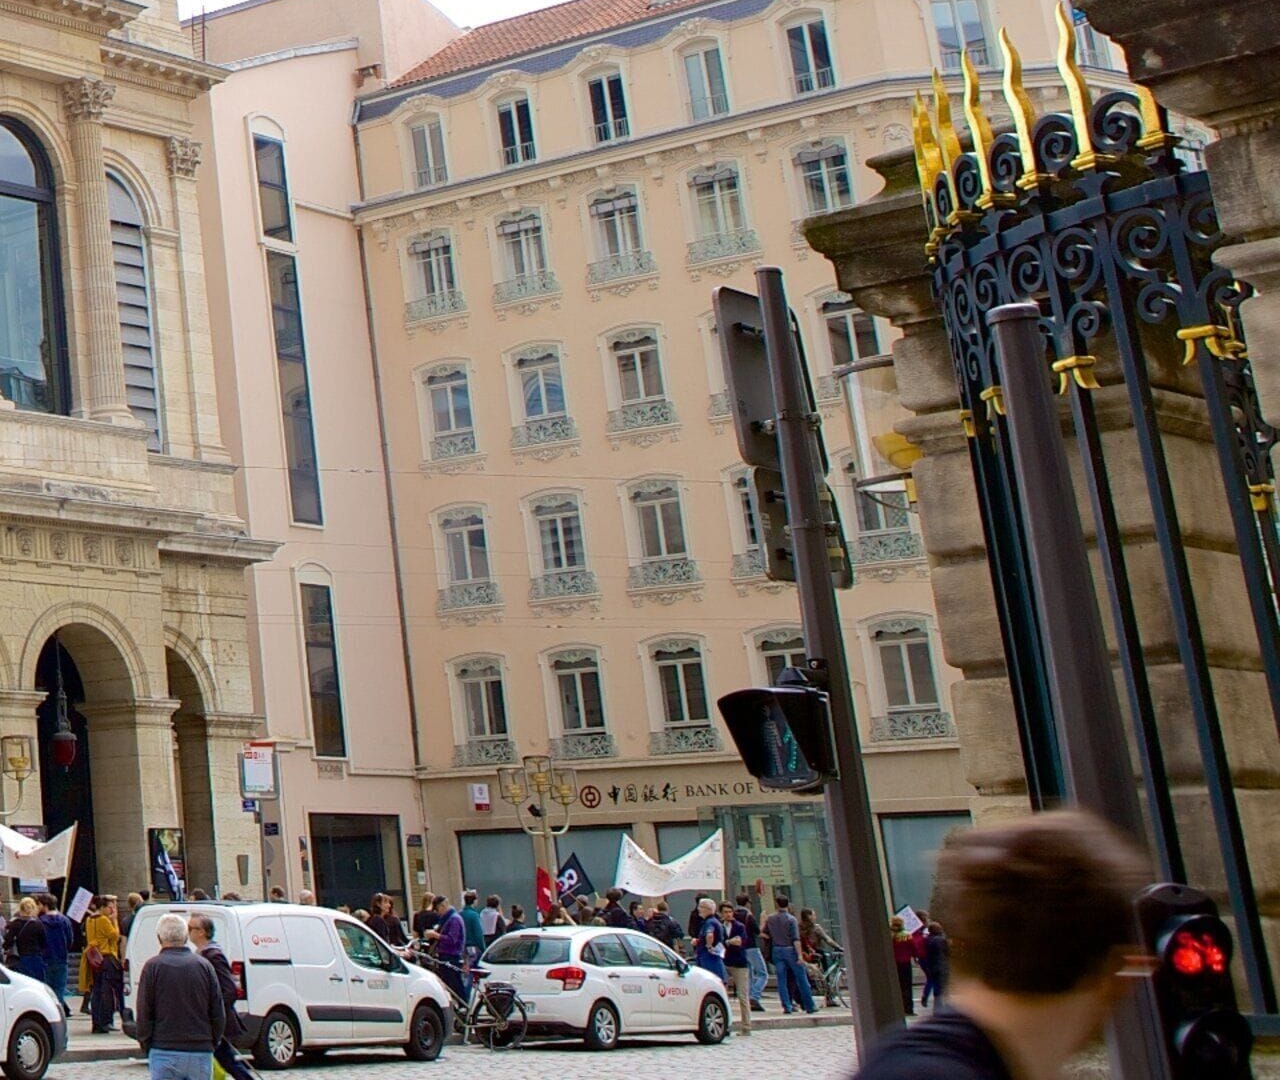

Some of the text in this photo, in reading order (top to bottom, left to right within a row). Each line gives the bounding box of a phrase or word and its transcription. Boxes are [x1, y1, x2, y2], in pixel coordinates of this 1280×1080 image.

[685, 783, 730, 798] BANK
[733, 781, 754, 796] OF
[737, 850, 782, 864] métro
[665, 986, 689, 997] VEOLIA
